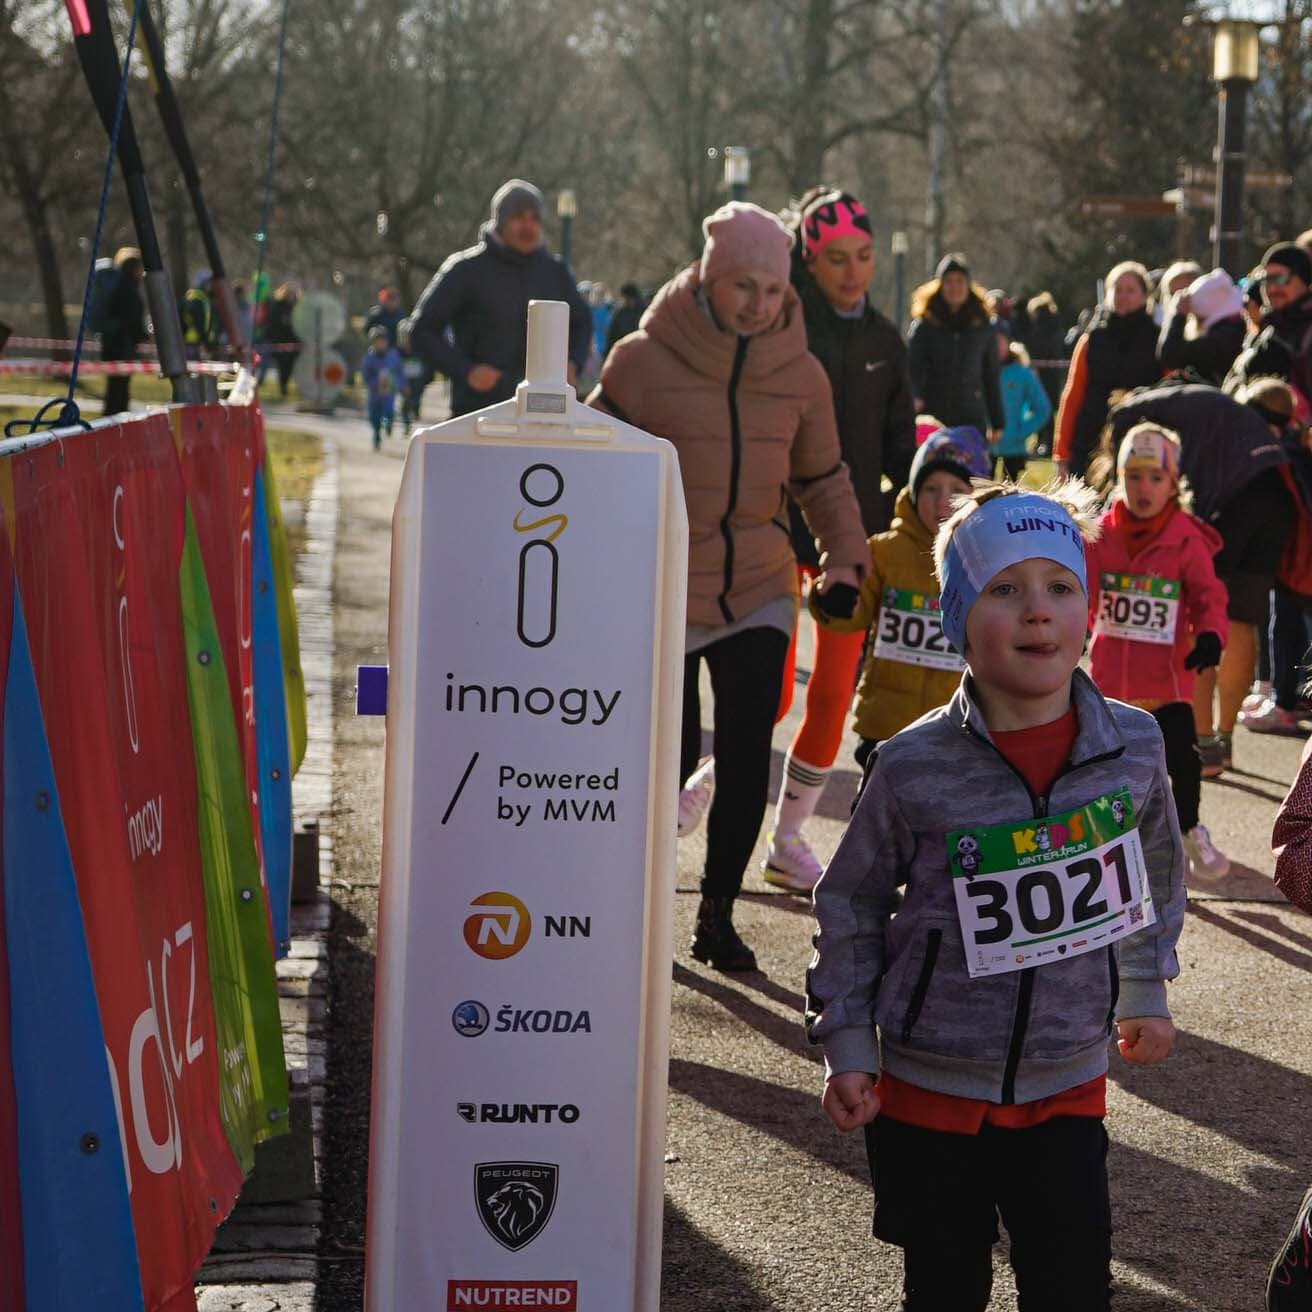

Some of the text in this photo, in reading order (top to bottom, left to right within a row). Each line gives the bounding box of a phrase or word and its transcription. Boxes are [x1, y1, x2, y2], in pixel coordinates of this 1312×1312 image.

[1006, 518, 1084, 554] WINTE
[1103, 592, 1169, 628] 3093
[445, 673, 622, 725] innogy
[499, 765, 620, 791] Powered
[496, 797, 617, 827] by MVM
[1017, 848, 1064, 866] WINTER
[965, 843, 1132, 945] 3021
[544, 916, 592, 938] NN
[494, 1004, 592, 1033] ŠKODA
[481, 1103, 580, 1124] RUNTO
[482, 1169, 551, 1179] PEUGEOT
[455, 1287, 571, 1305] NUTREND
